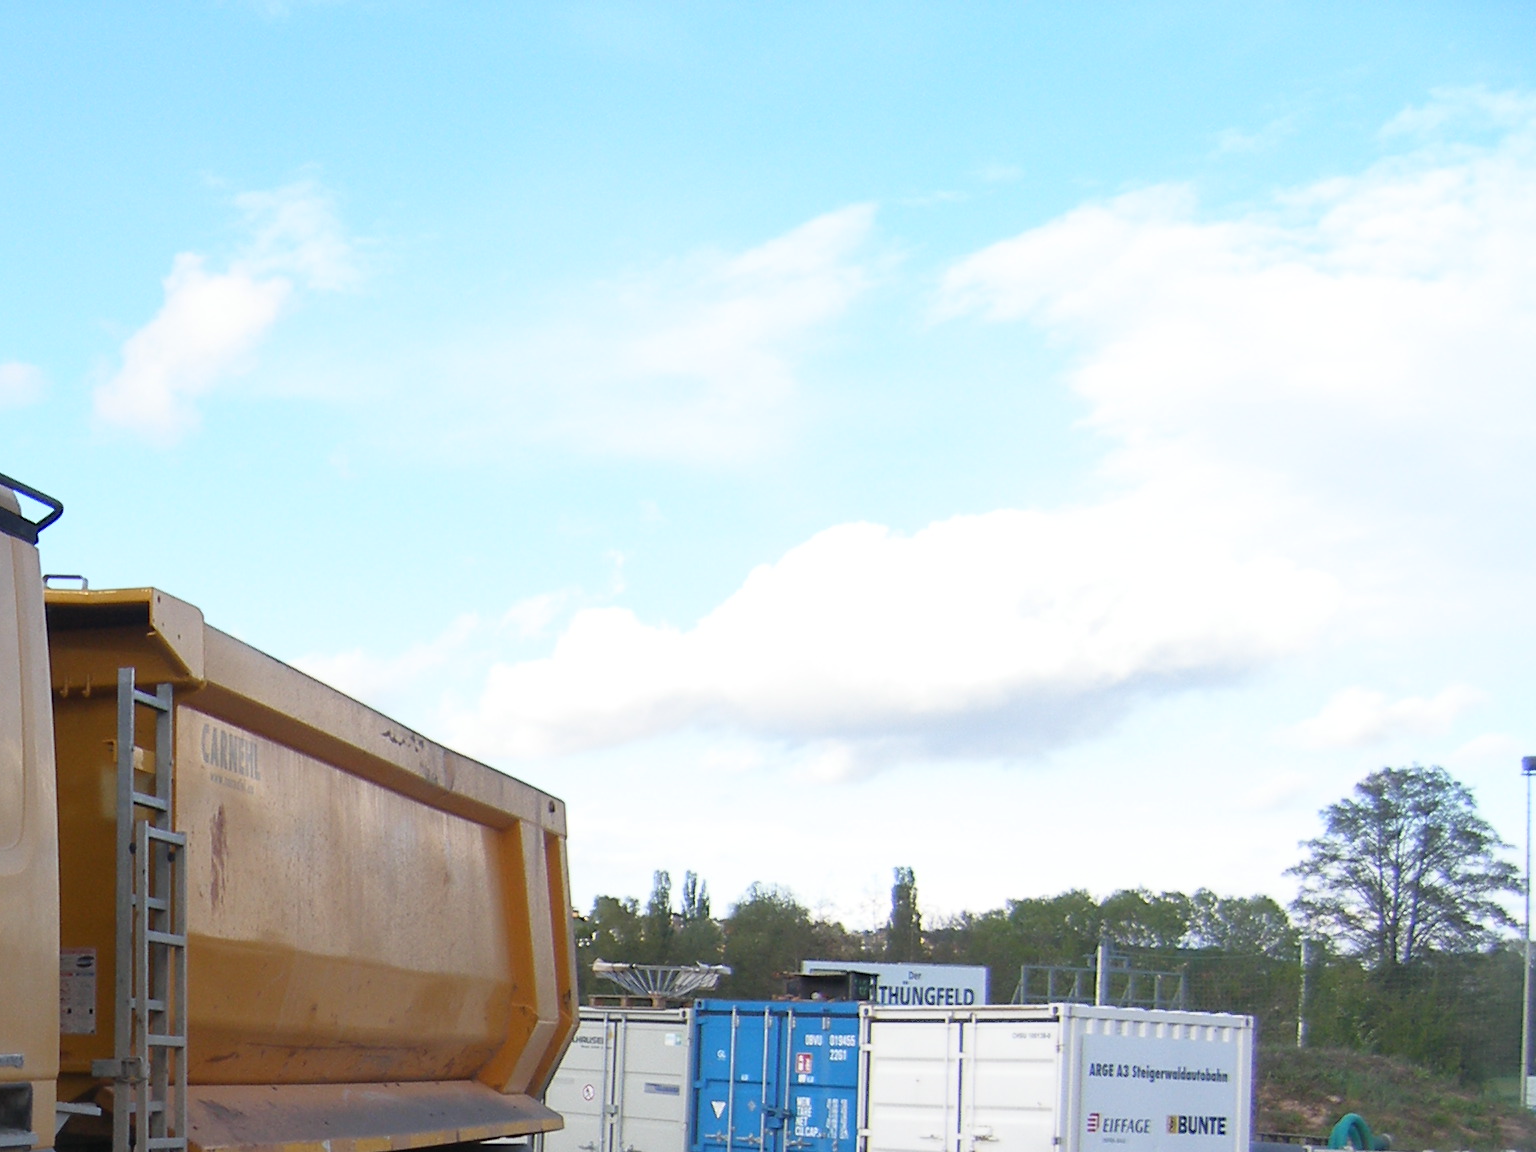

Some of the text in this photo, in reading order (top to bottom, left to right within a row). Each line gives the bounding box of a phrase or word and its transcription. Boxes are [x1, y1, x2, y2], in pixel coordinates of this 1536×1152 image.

[201, 724, 260, 780] CARNEHL
[908, 971, 922, 980] Der
[878, 981, 975, 1005] THÜNGFELD
[1089, 1063, 1228, 1083] ARGE A3 Steigerwaldautobahn
[1102, 1118, 1151, 1133] EIFFAGE
[1178, 1115, 1227, 1135] BUNTE
